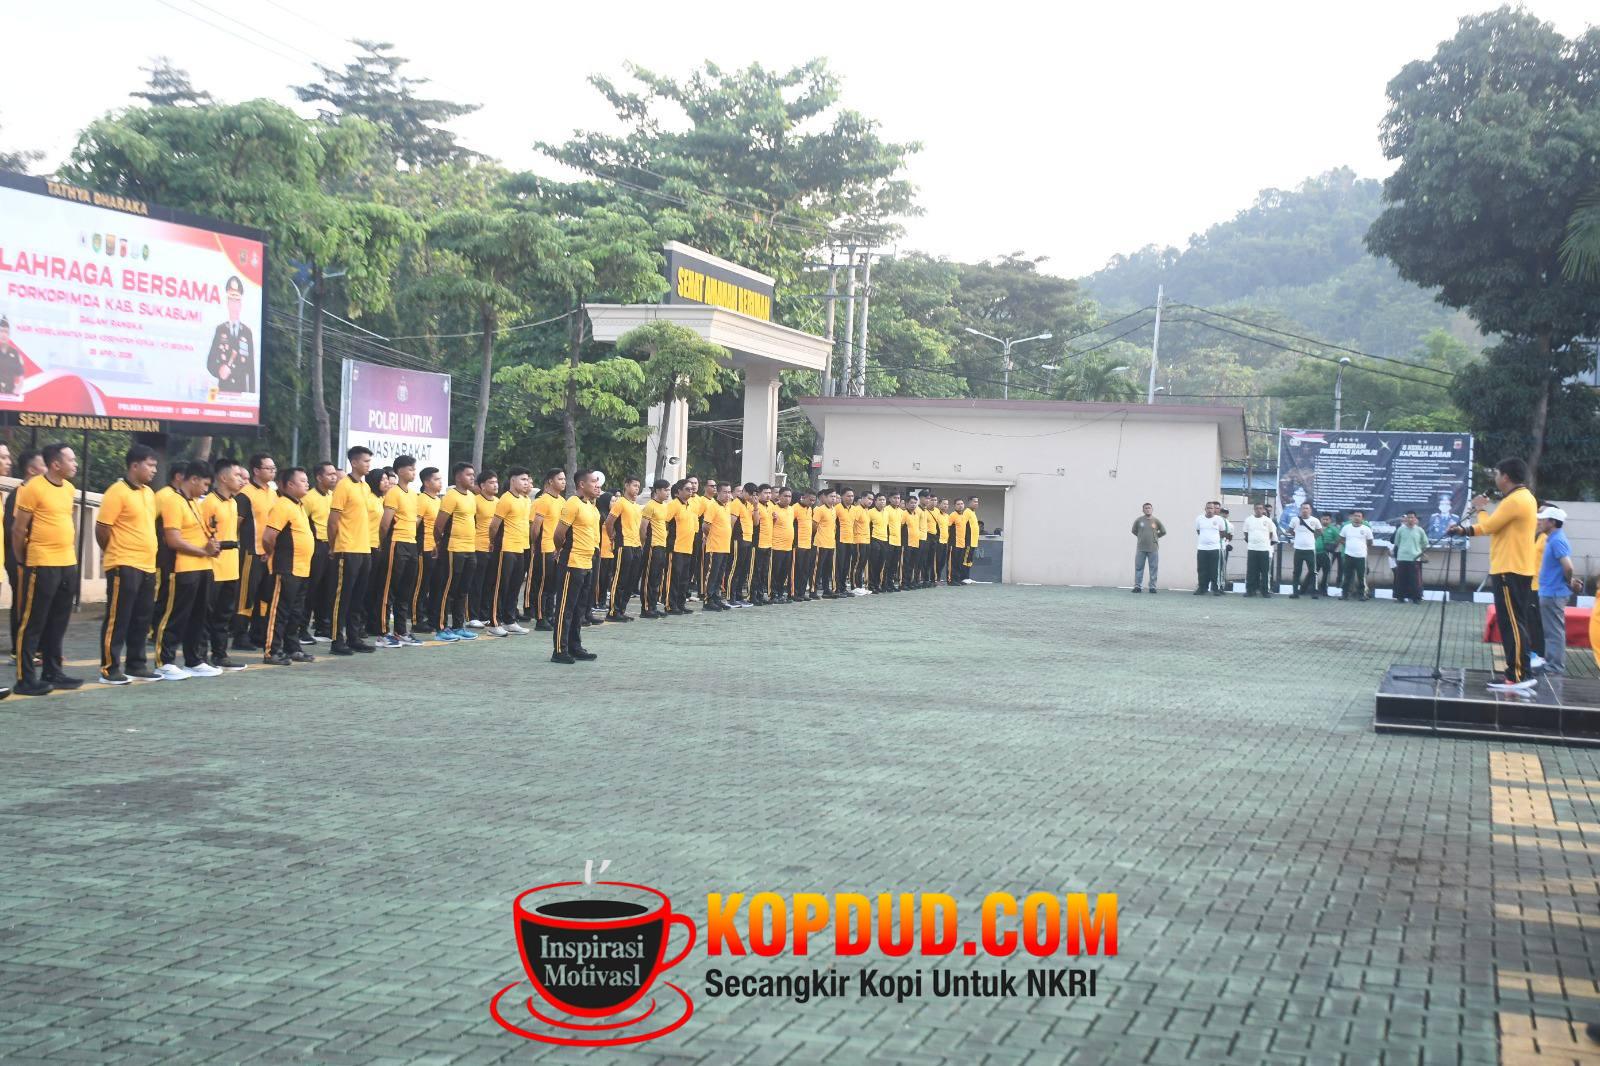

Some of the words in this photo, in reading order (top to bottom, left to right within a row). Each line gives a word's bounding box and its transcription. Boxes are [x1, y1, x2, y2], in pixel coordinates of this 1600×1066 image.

[122, 269, 221, 304] BERSAMA
[139, 302, 202, 322] SUKABUMI
[19, 413, 58, 428] SEHAT
[59, 415, 110, 431] AMANAH
[111, 418, 160, 433] BERIMAN
[368, 409, 399, 429] POLRI
[400, 413, 433, 434] UNTUK
[368, 440, 432, 461] MASYARAKAT
